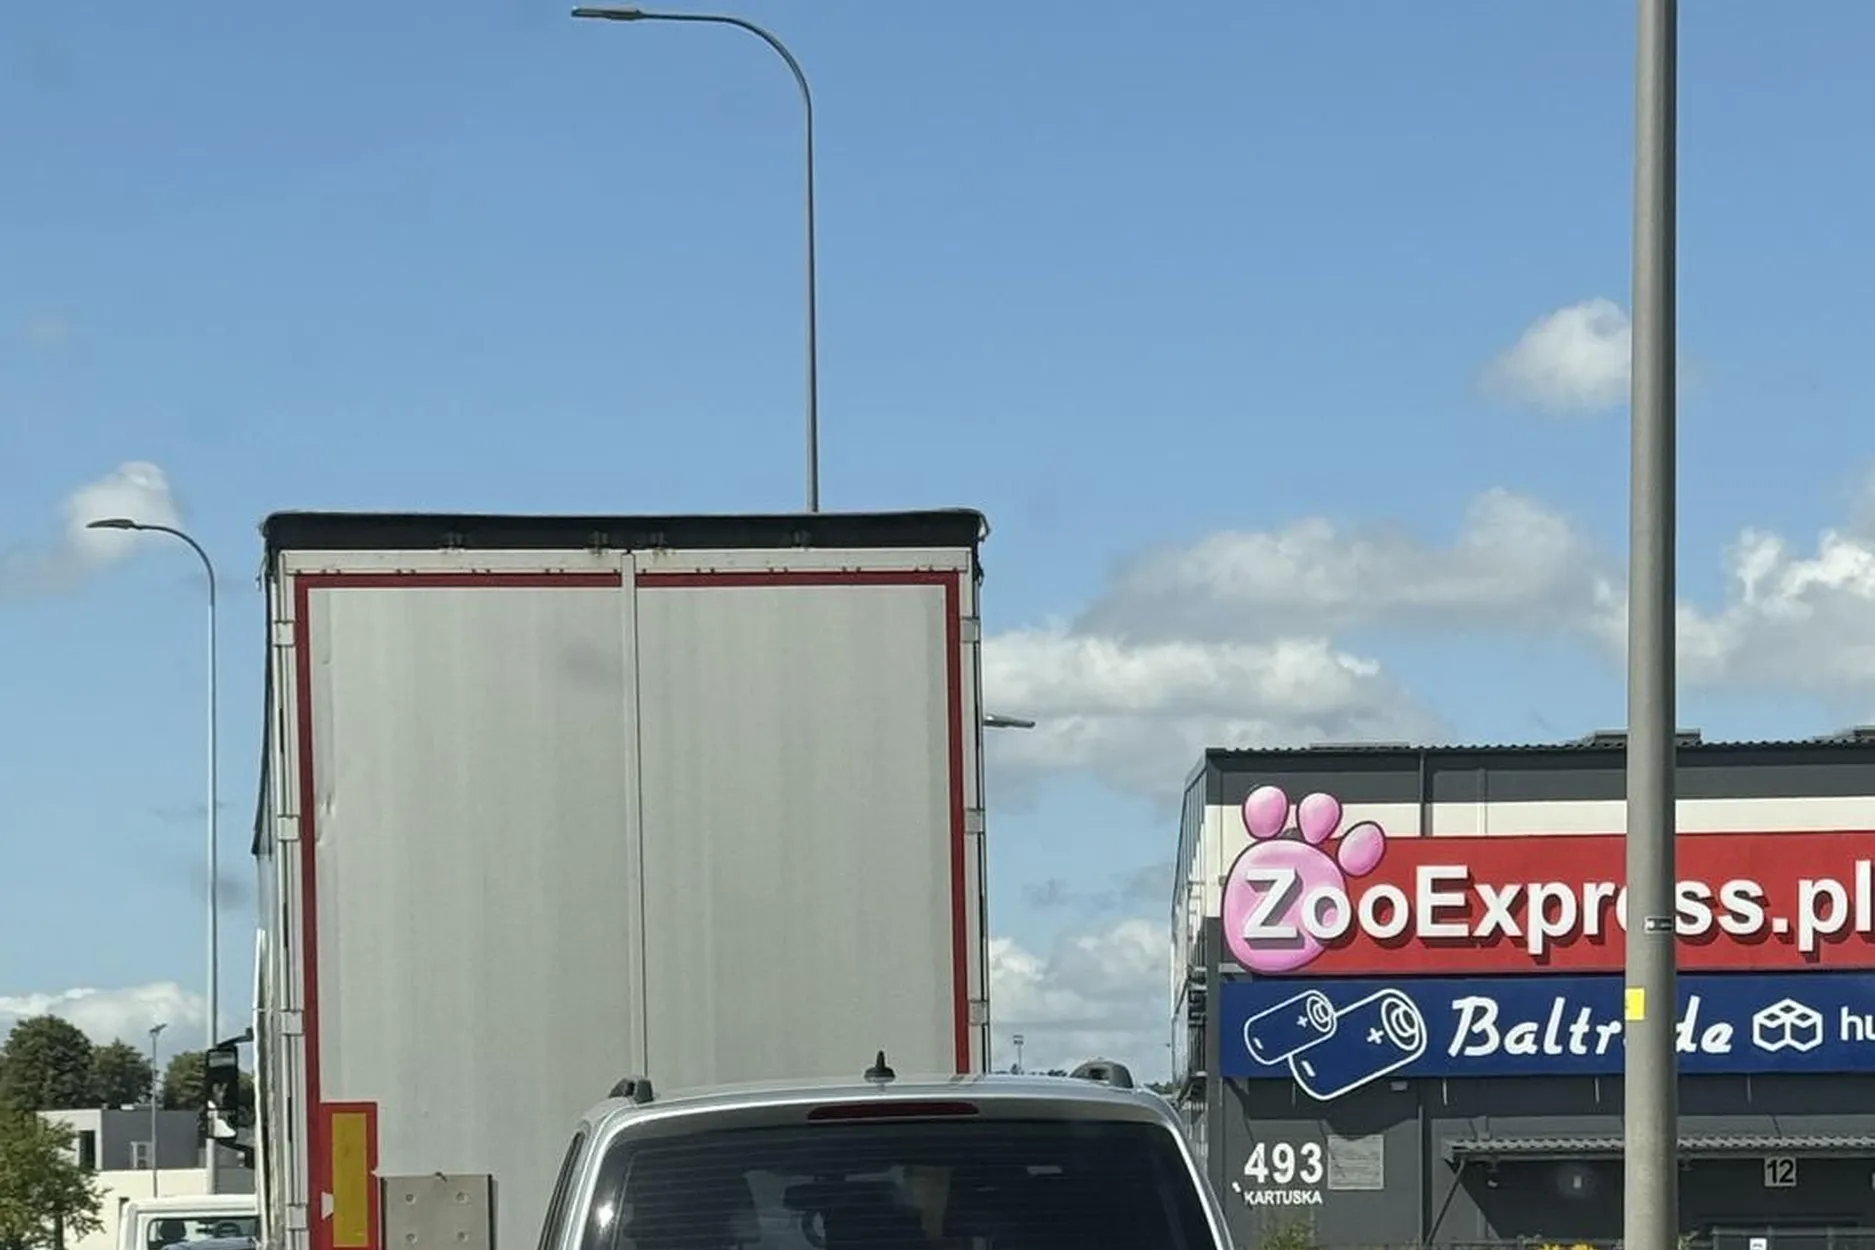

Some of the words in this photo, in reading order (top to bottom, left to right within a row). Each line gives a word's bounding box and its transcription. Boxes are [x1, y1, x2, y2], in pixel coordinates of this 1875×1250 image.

[1243, 860, 1872, 955] ZooExprss.pl
[1448, 995, 1735, 1057] Baltrde
[1244, 1142, 1324, 1184] 493
[1766, 1158, 1795, 1184] 12
[1244, 1190, 1323, 1205] KARTUSKA
